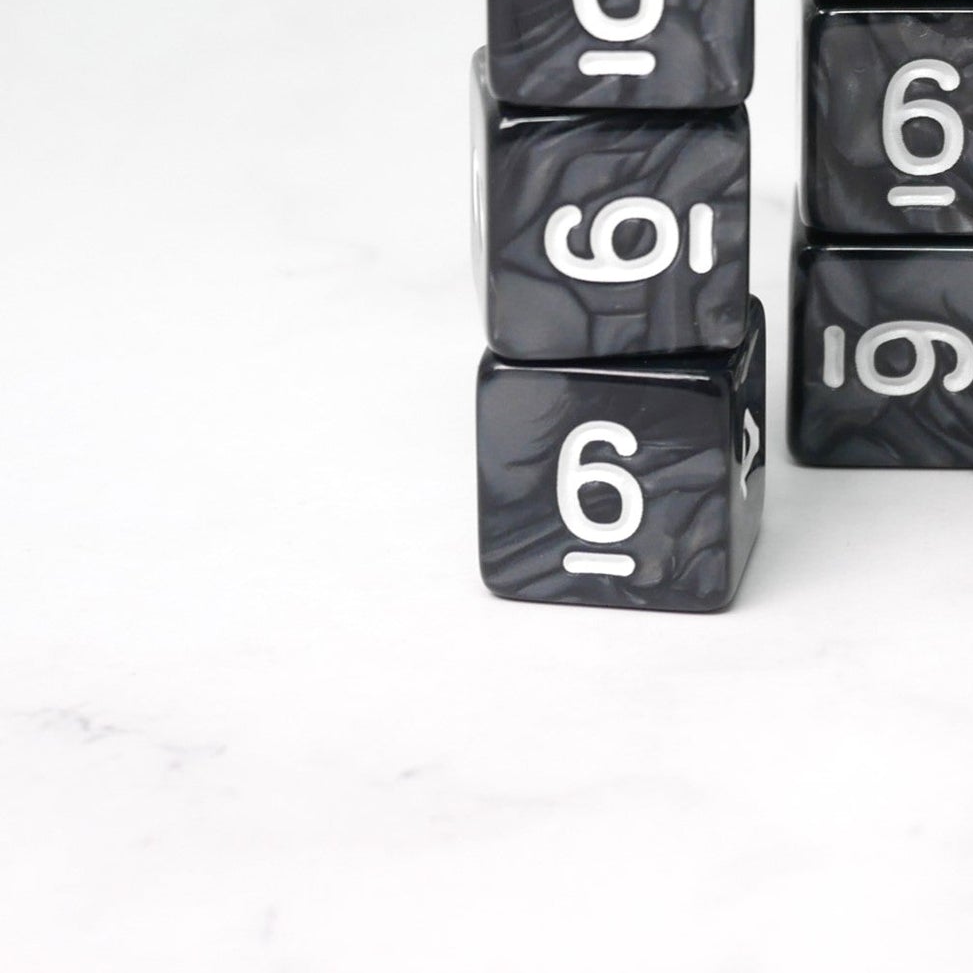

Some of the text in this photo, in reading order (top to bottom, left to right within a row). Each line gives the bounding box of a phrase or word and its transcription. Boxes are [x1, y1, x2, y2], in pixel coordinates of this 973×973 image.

[881, 58, 965, 208] 6
[543, 196, 718, 284] 6
[556, 420, 644, 578] 6
